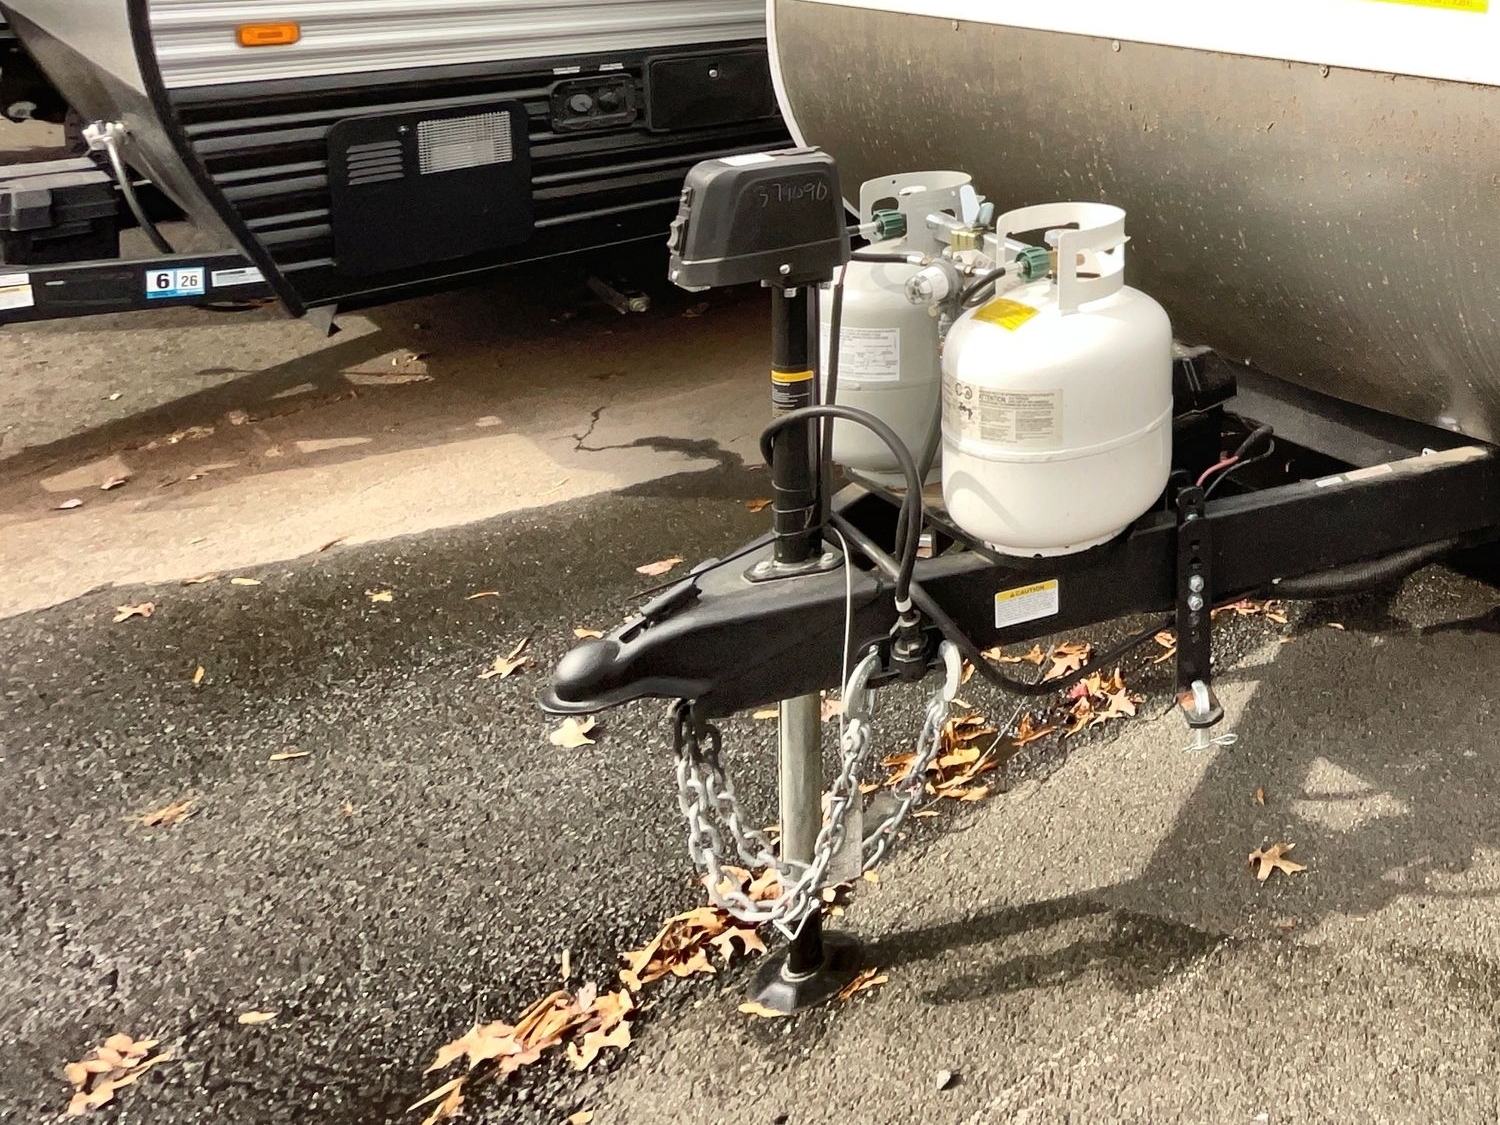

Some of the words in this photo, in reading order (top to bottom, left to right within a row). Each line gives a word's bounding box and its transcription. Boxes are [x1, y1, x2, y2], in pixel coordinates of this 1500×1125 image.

[156, 272, 171, 290] 6
[180, 274, 199, 288] 26
[1015, 584, 1045, 597] CAUTION
